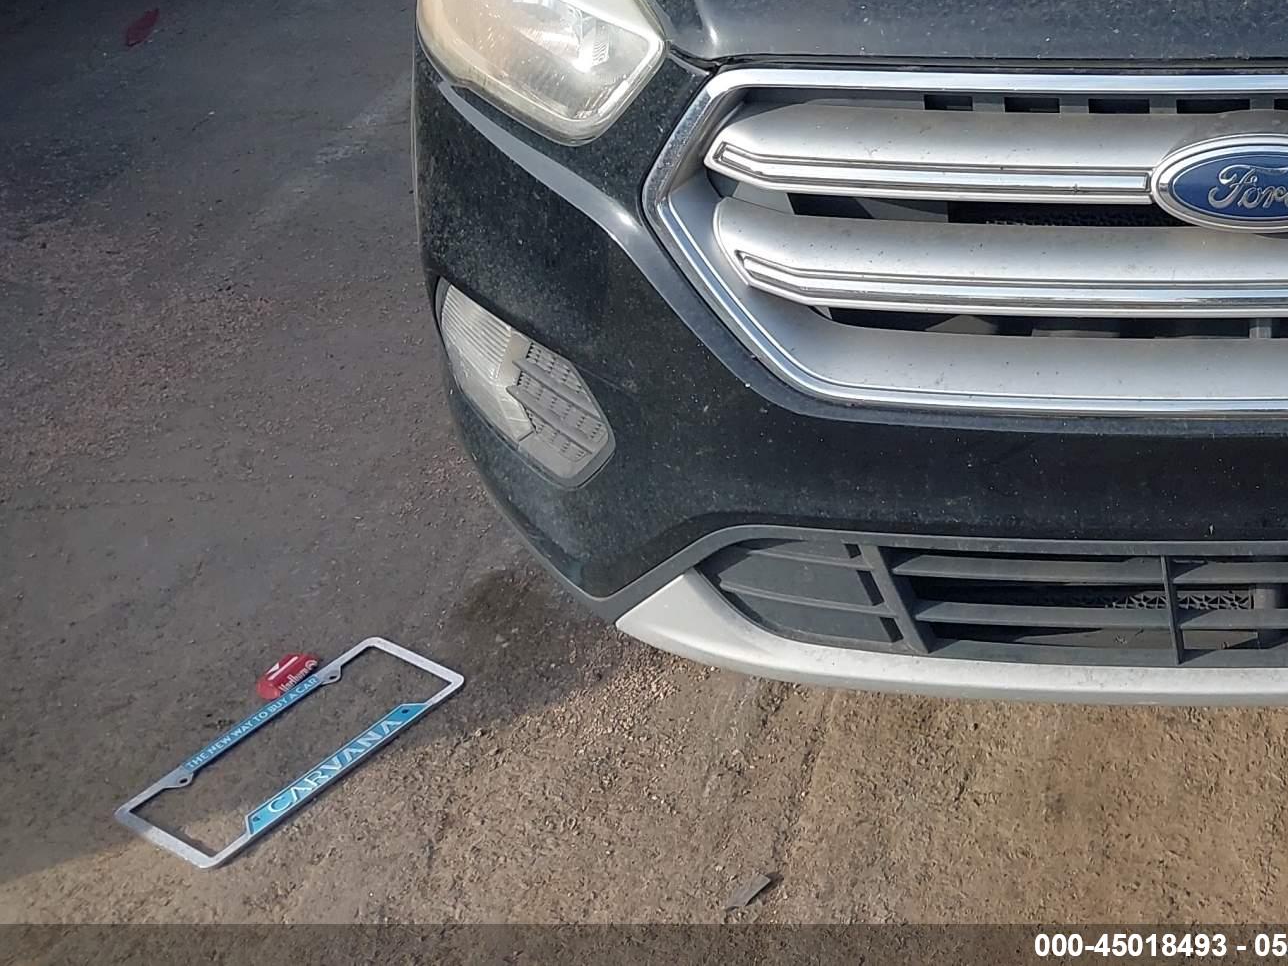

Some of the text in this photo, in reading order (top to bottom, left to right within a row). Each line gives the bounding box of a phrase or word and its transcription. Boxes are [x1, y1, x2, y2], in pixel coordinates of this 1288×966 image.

[185, 677, 318, 768] THE NEW WAY TO BUY A CAR
[267, 719, 403, 813] CARVANA
